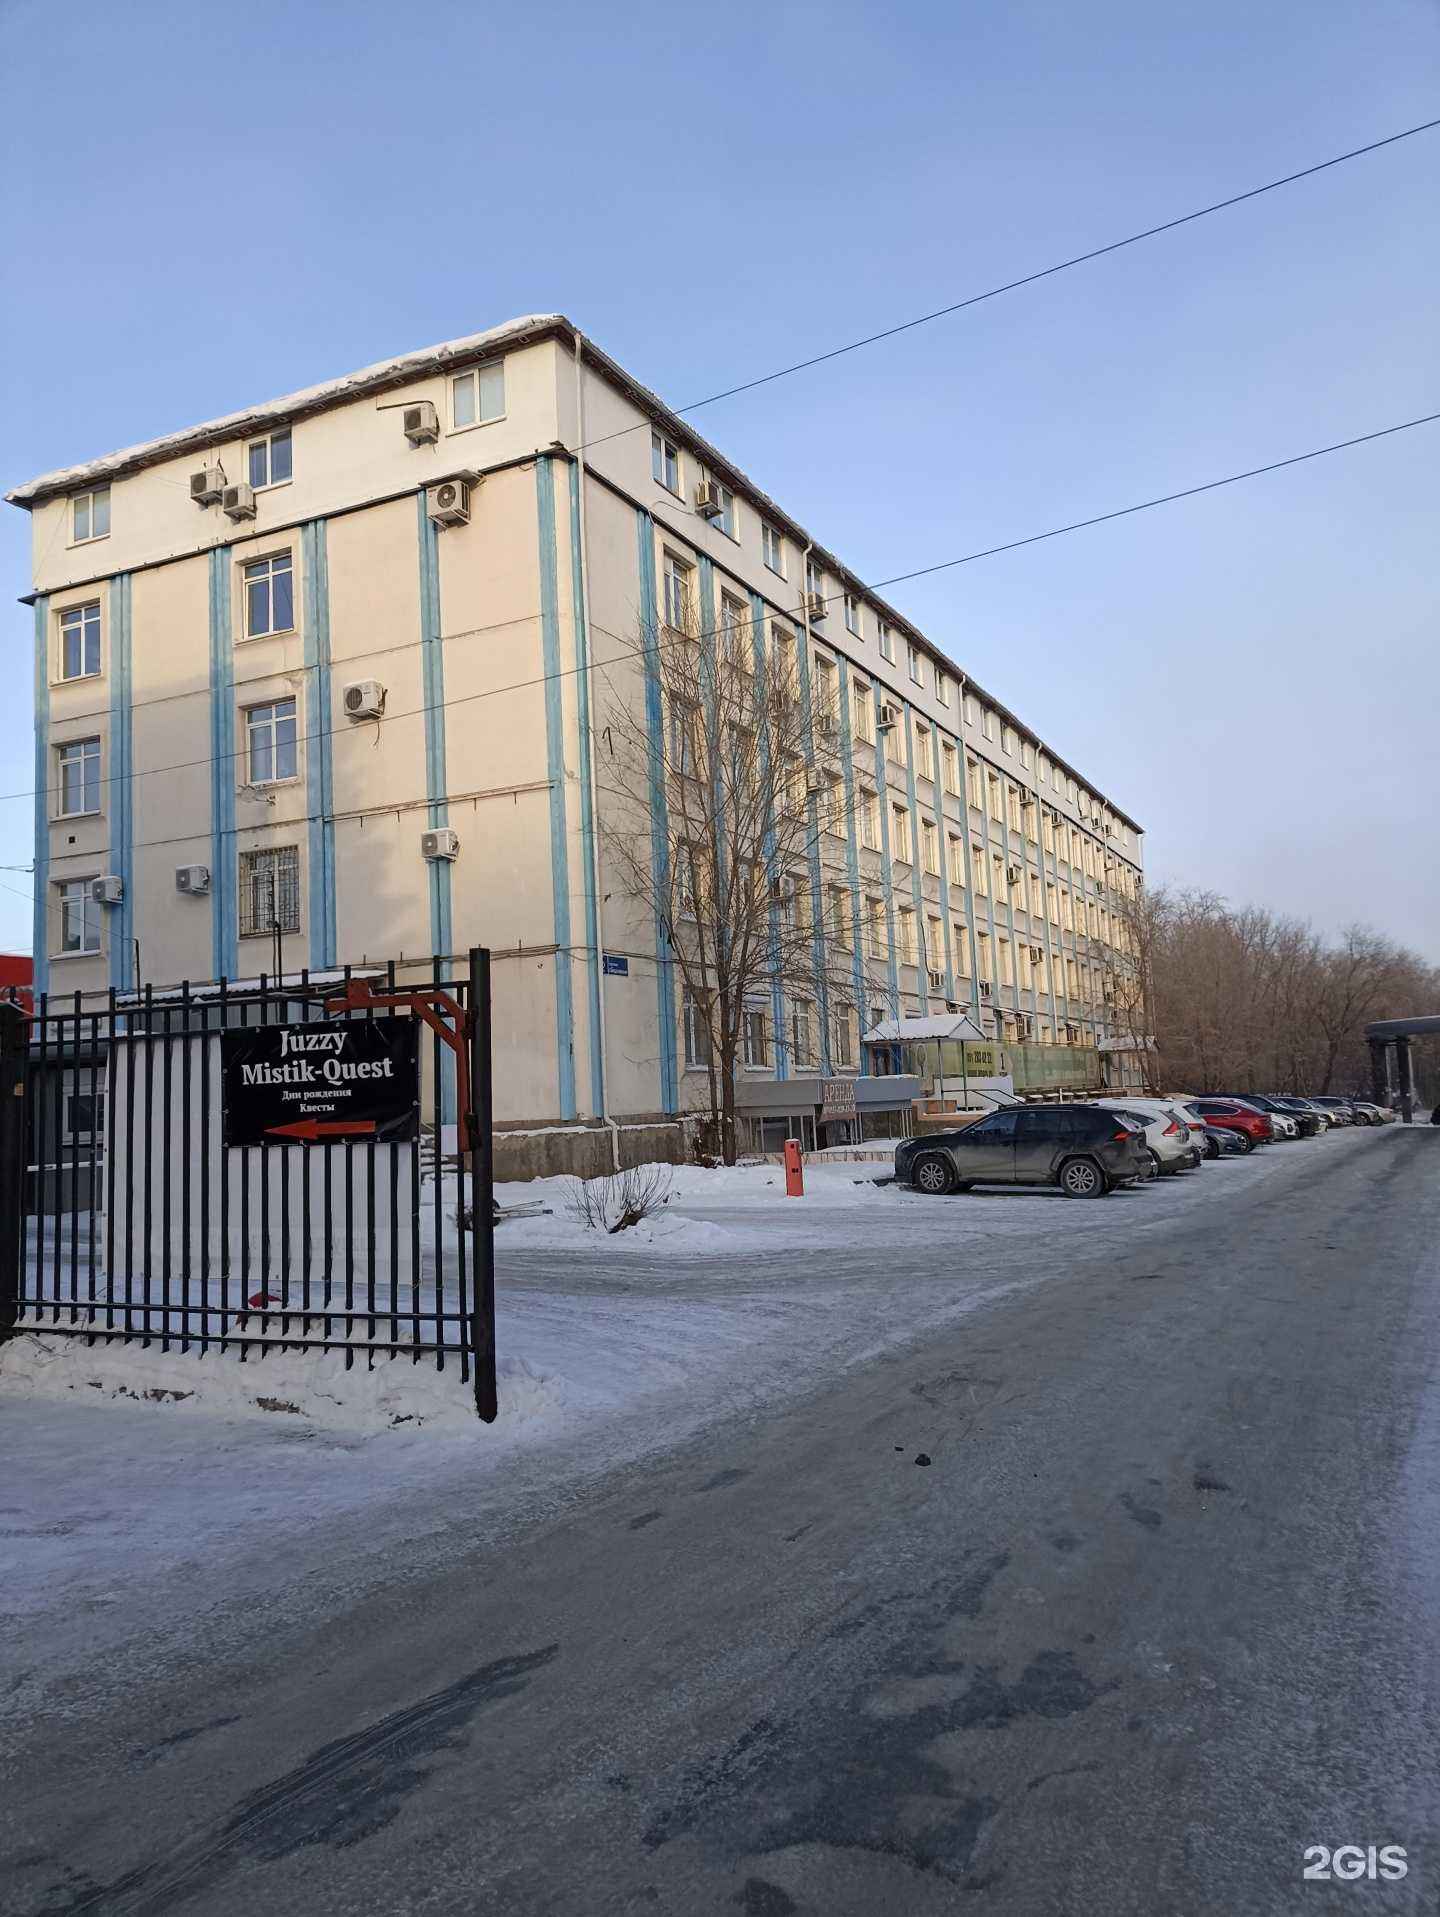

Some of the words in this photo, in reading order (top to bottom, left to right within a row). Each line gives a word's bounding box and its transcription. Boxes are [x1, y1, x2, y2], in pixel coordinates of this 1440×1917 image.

[279, 1030, 348, 1057] Juzzy
[241, 1057, 394, 1086] Mistik-Quest
[281, 1090, 302, 1101] Дни
[303, 1089, 352, 1101] рождения
[824, 1083, 855, 1104] АРЕНДА
[299, 1102, 335, 1113] Квесты
